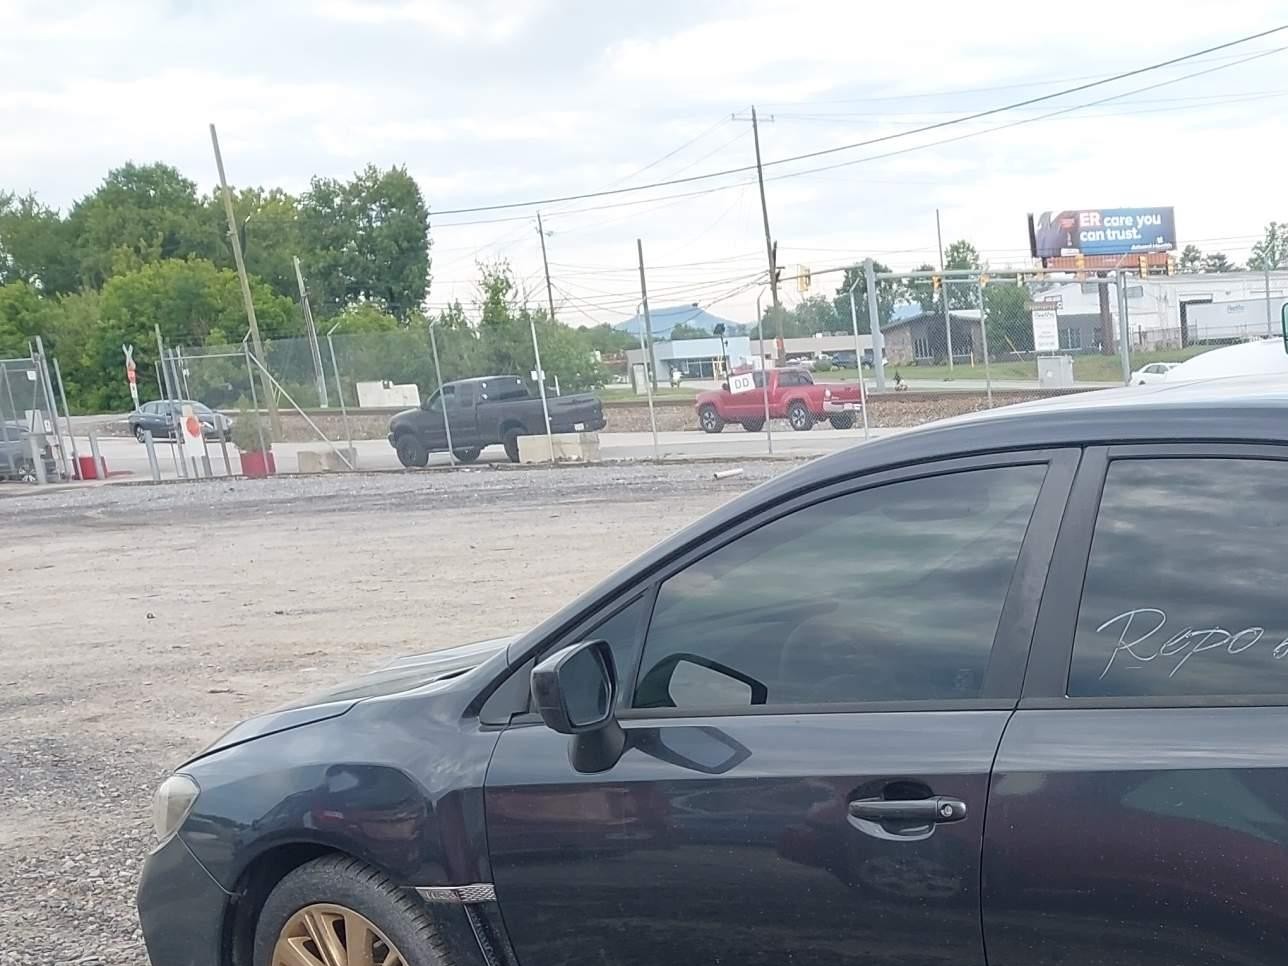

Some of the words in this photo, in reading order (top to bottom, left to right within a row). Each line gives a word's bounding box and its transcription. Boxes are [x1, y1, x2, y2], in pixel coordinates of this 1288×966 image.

[1080, 212, 1101, 227] ER
[1104, 215, 1133, 227] care
[1136, 214, 1161, 228] you
[1080, 230, 1104, 241] can
[1105, 227, 1142, 240] trust.
